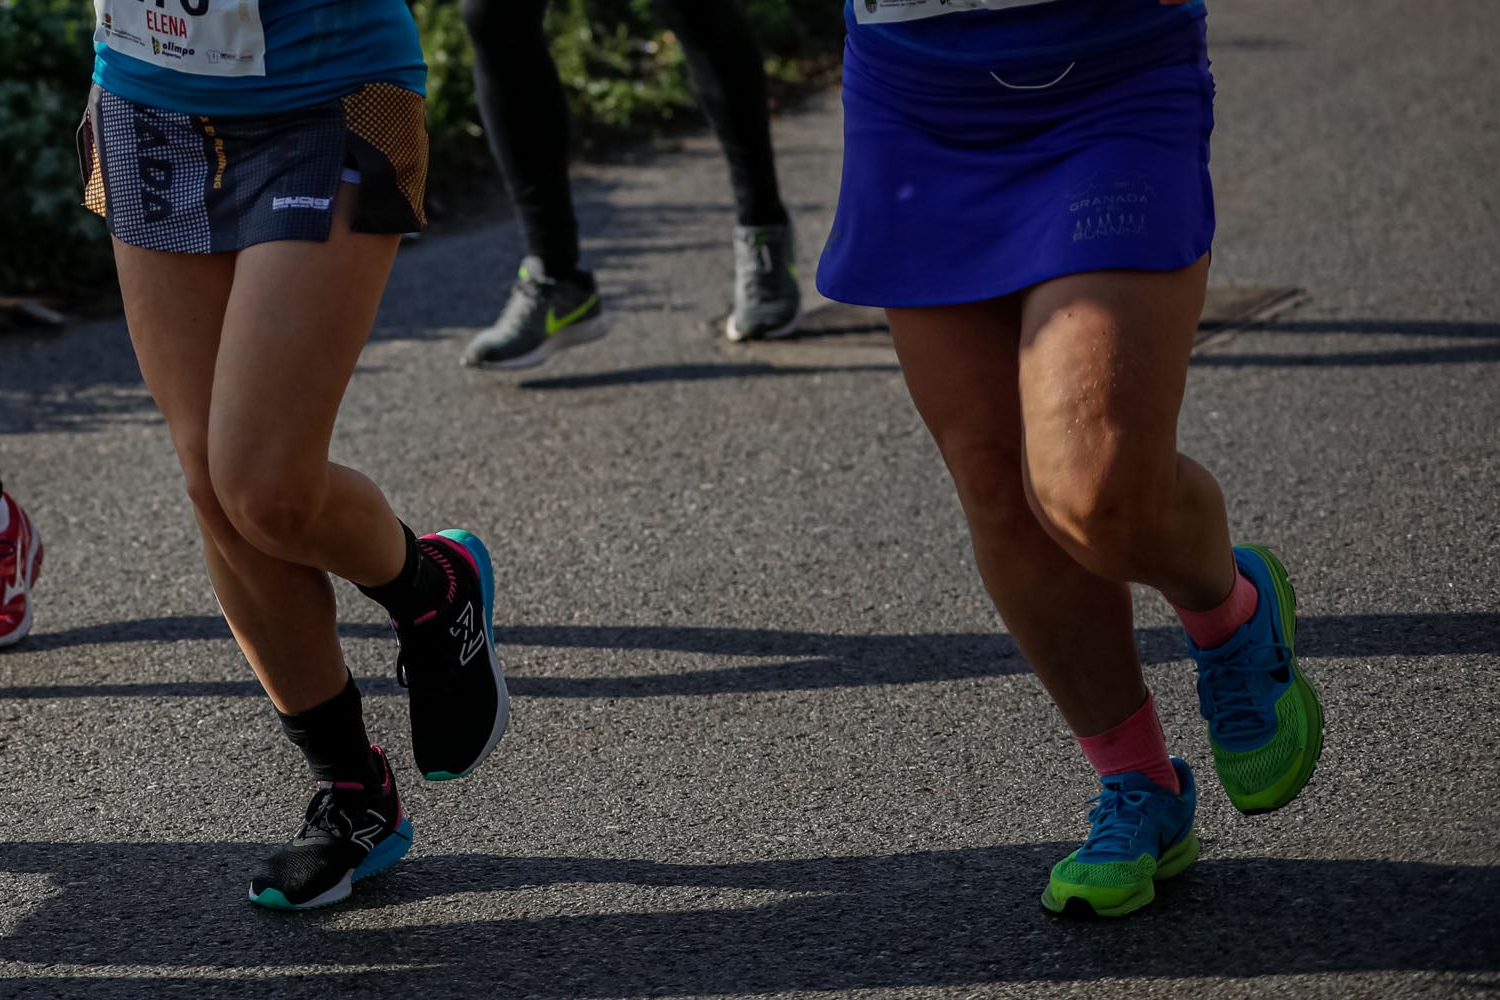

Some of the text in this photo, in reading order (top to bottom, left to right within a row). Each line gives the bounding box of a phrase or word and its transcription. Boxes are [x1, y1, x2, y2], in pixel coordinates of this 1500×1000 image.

[146, 9, 188, 39] ELENA
[162, 41, 196, 56] olimpo
[1068, 192, 1149, 212] GRANADA
